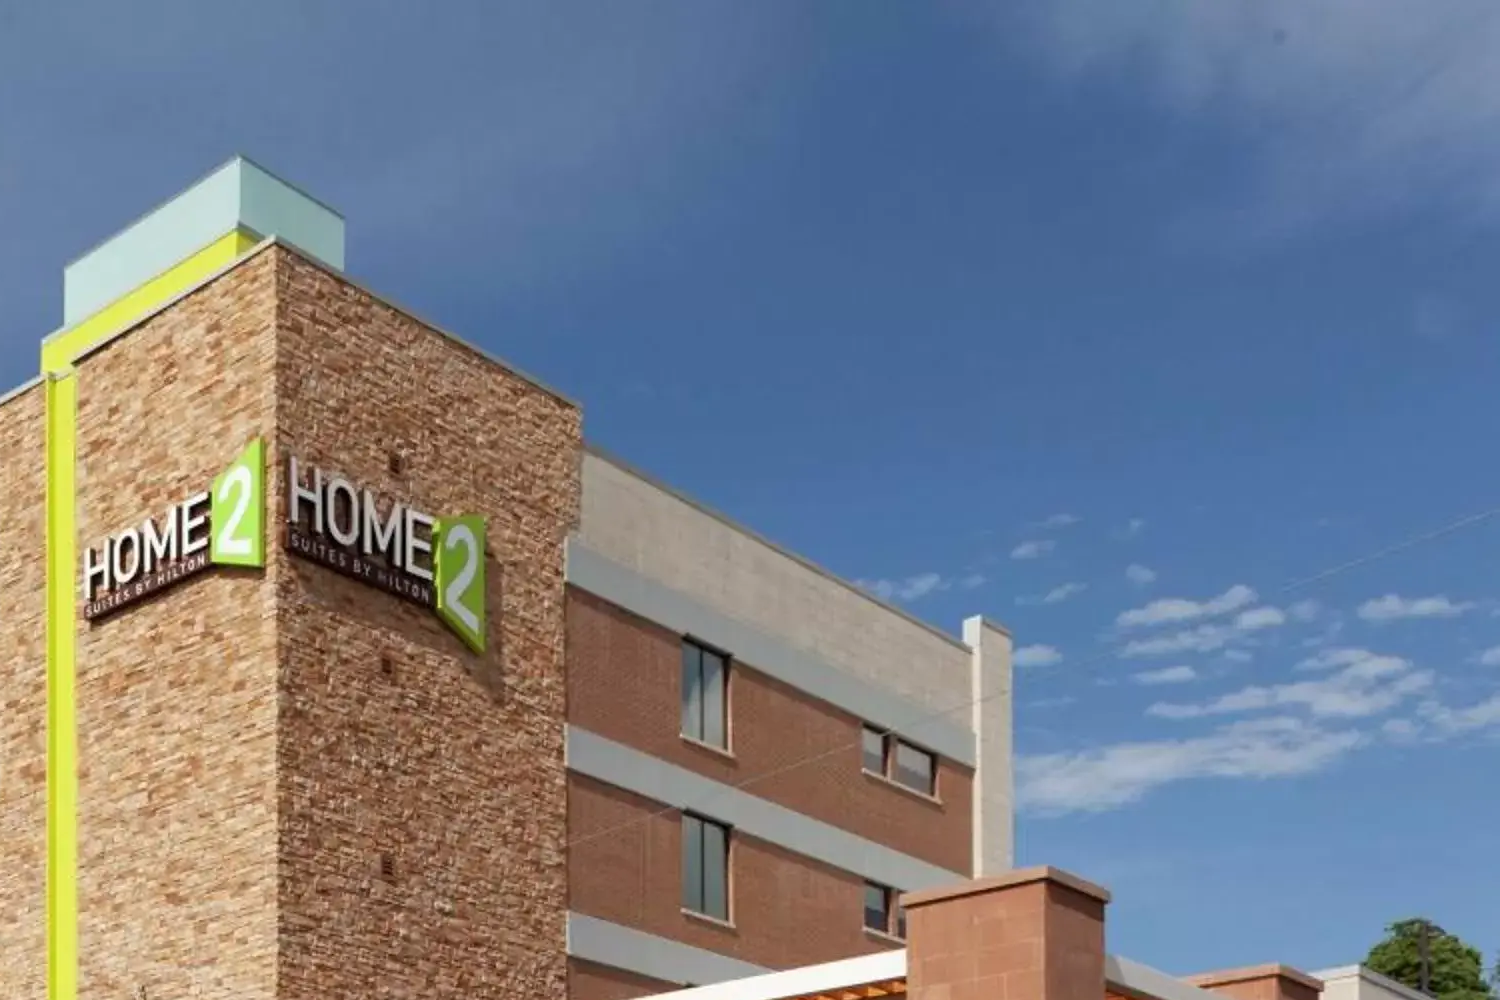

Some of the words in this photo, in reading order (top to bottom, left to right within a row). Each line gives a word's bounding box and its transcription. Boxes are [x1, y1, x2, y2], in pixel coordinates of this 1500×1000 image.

[85, 591, 131, 617] SUITES
[135, 576, 151, 595] BY
[156, 557, 206, 587] HILTON
[292, 532, 346, 567] SUITES
[353, 559, 372, 577] BY
[377, 570, 430, 604] HILTON
